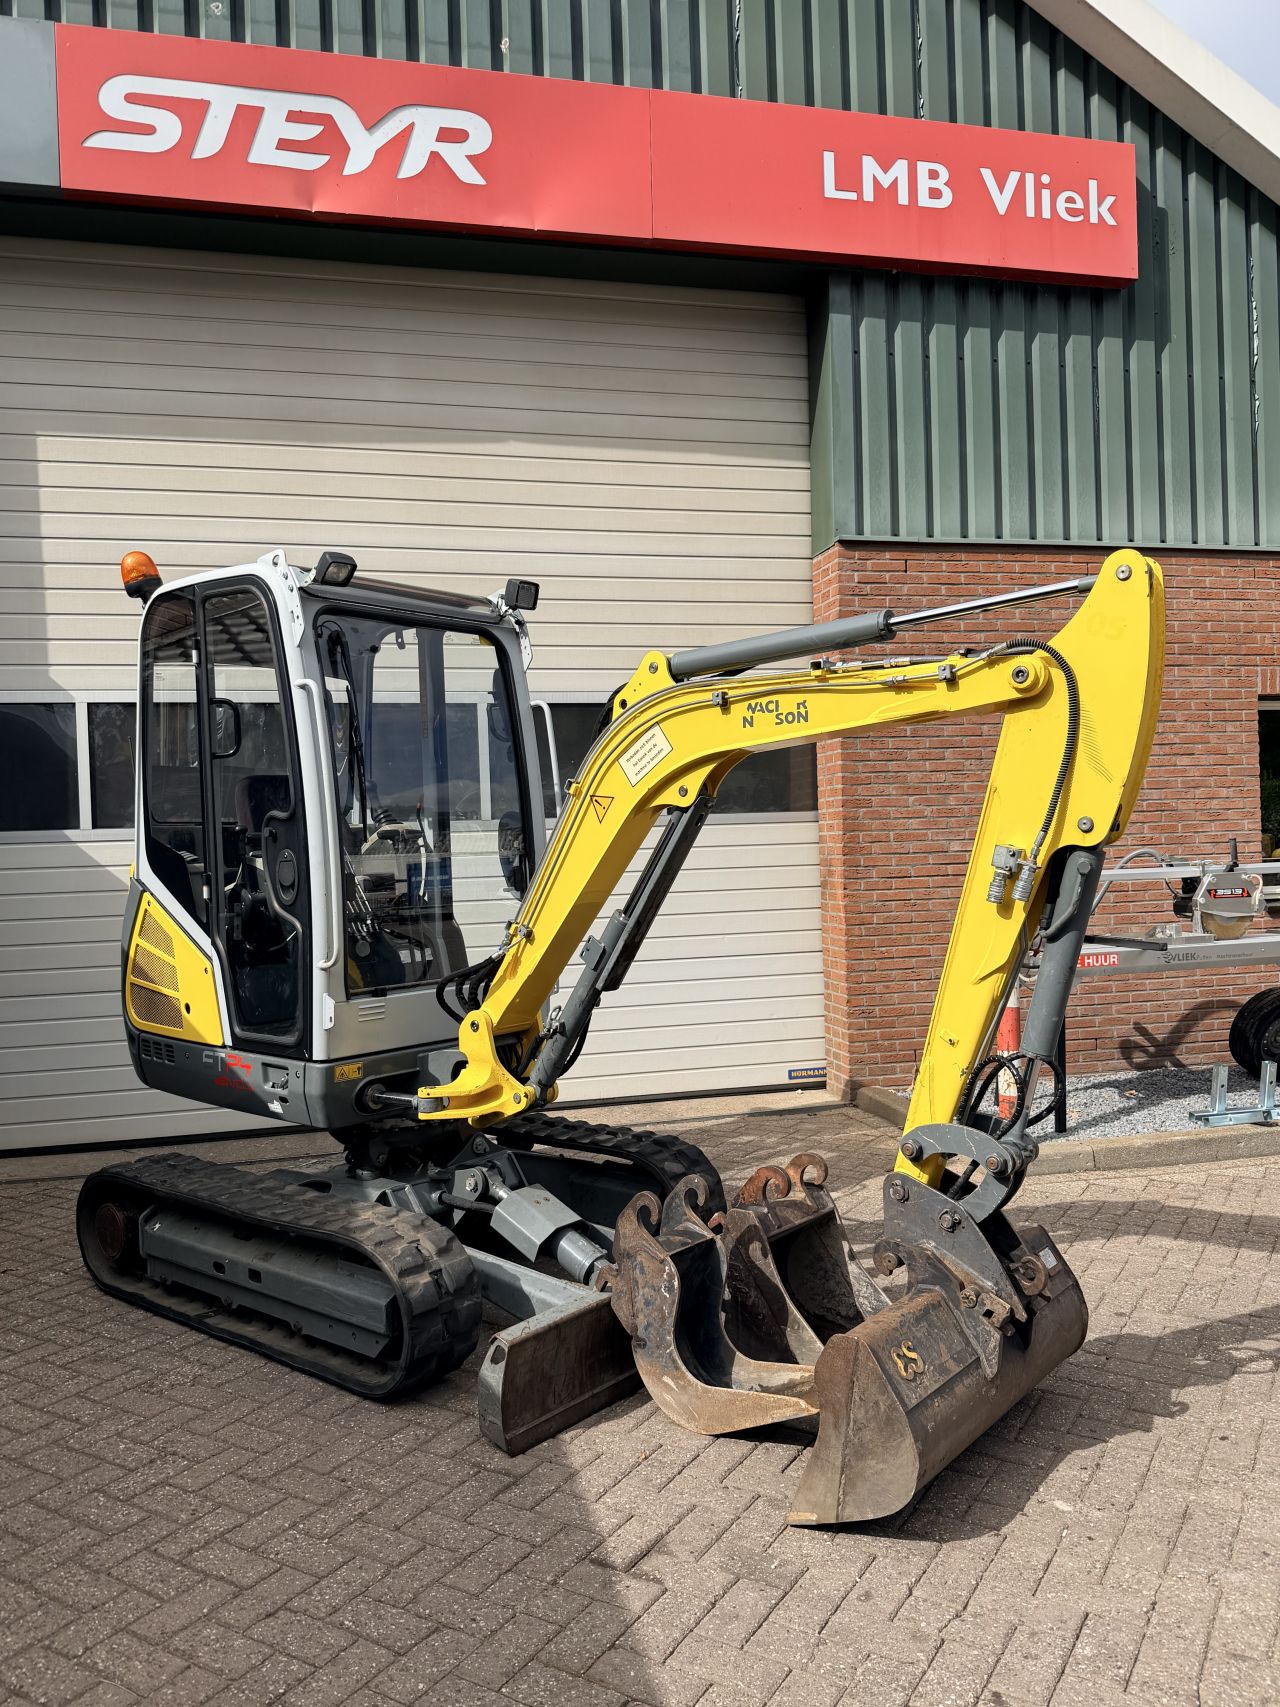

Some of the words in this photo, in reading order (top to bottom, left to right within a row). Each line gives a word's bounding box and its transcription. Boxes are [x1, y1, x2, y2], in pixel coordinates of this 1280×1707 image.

[81, 73, 493, 186] STEYR
[823, 150, 953, 209] LMB
[979, 167, 1118, 226] Vliek
[1084, 954, 1118, 967] HUUR
